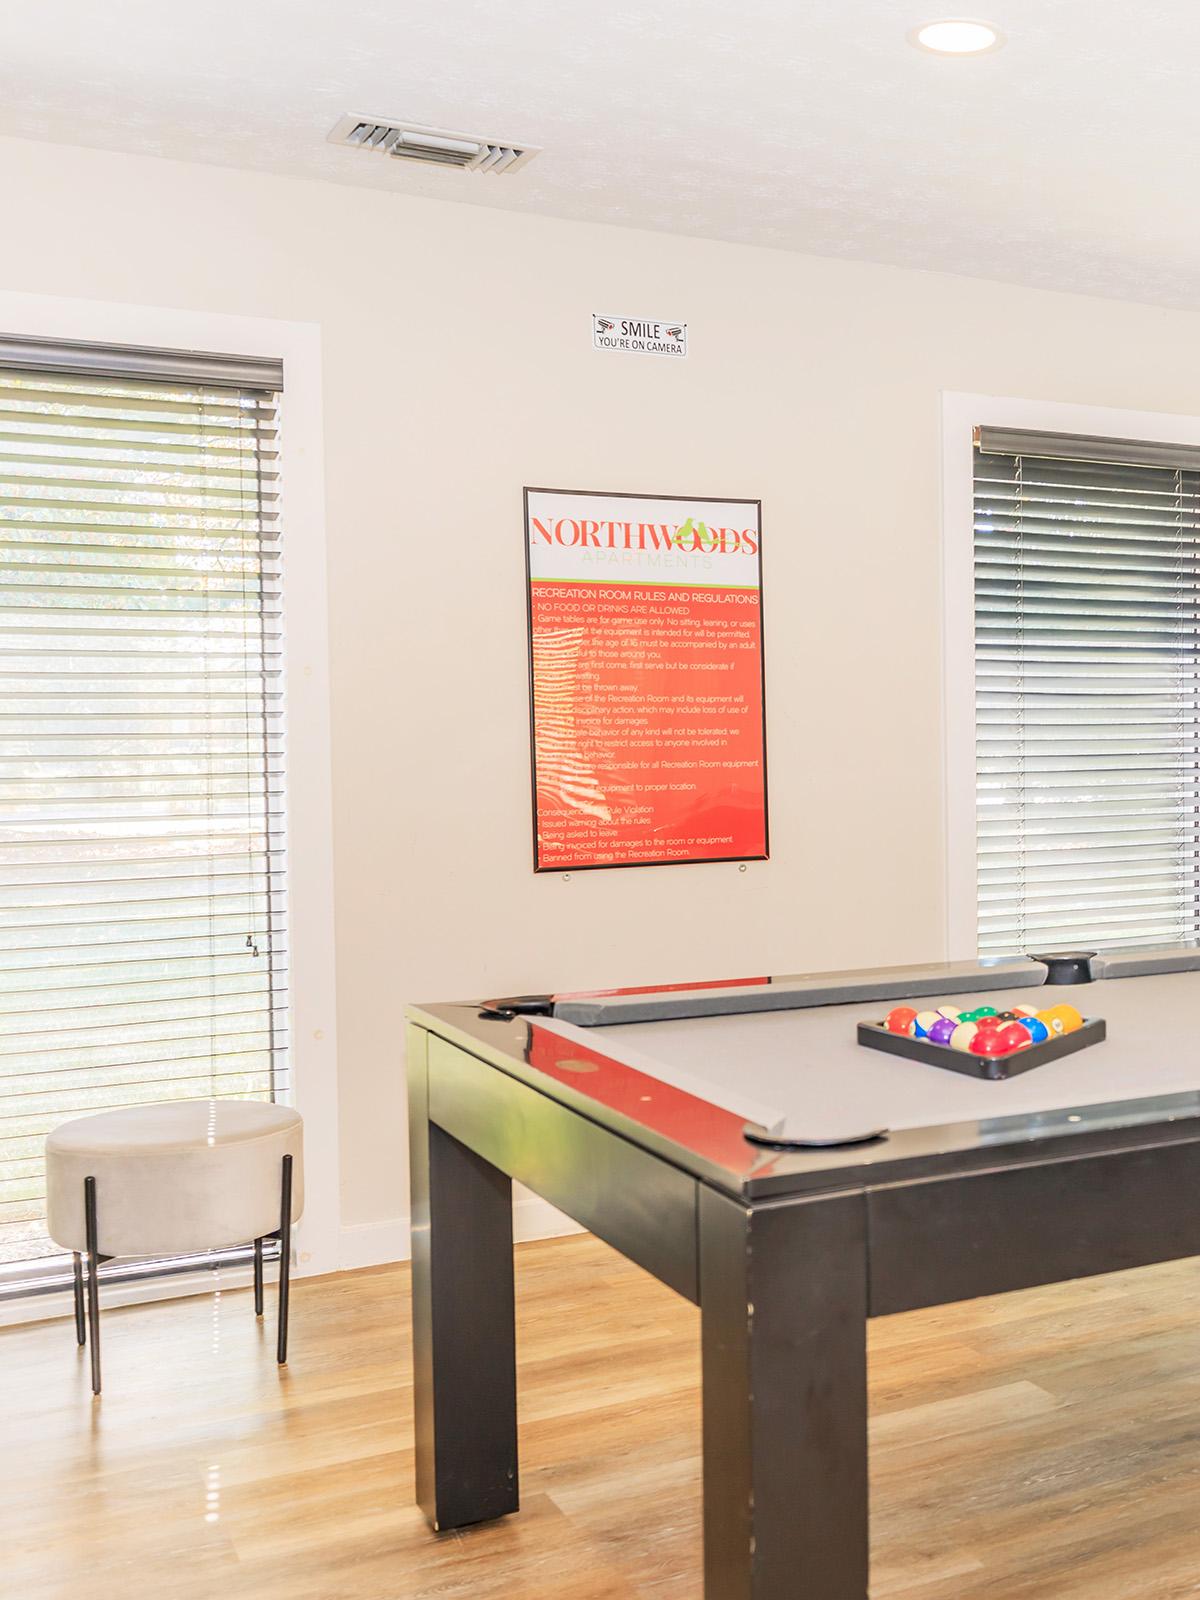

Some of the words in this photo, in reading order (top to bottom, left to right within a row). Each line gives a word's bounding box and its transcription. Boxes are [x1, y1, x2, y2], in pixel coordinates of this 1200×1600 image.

[621, 321, 660, 339] SMILE
[598, 336, 630, 349] YOU'RE
[631, 340, 645, 350] ON
[646, 341, 683, 354] CAMERA
[531, 517, 758, 556] NORTHWOODS
[581, 550, 713, 570] APARTMENTS
[531, 587, 597, 599] RECREATION
[599, 589, 632, 600] ROOM
[634, 591, 666, 602] RULES
[668, 592, 690, 602] AND
[692, 593, 759, 605] REGULATIONS
[537, 603, 553, 612] NO
[554, 603, 581, 612] FOOD
[582, 604, 596, 613] OR
[597, 604, 629, 614] DRINKS
[630, 605, 648, 615] ARE
[649, 606, 690, 615] ALLOWED
[537, 614, 561, 623] Game
[562, 615, 585, 624] tables
[586, 616, 599, 624] are
[599, 615, 609, 624] for
[610, 617, 632, 626] game
[634, 617, 648, 625] use
[667, 618, 679, 626] No
[740, 620, 756, 629] uses
[603, 628, 642, 637] equipment
[651, 629, 682, 637] intended
[682, 629, 693, 637] for
[695, 629, 705, 637] will
[706, 630, 716, 638] be
[605, 640, 619, 648] age
[620, 639, 630, 647] of
[641, 640, 658, 648] must
[659, 640, 669, 648] be
[670, 640, 718, 649] accompanied
[718, 641, 729, 650] by
[597, 649, 619, 658] those
[620, 649, 646, 658] around
[590, 661, 604, 669] first
[629, 661, 644, 670] first
[666, 662, 678, 670] but
[679, 662, 689, 670] be
[690, 662, 729, 671] considerate
[582, 684, 593, 692] be
[594, 684, 618, 692] thrown
[594, 694, 607, 702] the
[608, 694, 645, 703] Recreation
[647, 694, 670, 703] Room
[671, 695, 685, 703] and
[686, 695, 695, 703] its
[695, 695, 733, 704] equipment
[734, 695, 744, 703] will
[637, 705, 657, 714] which
[658, 707, 675, 715] may
[676, 706, 701, 714] include
[702, 706, 717, 714] loss
[718, 706, 726, 714] of
[727, 706, 740, 714] use
[741, 706, 749, 714] of
[576, 717, 601, 726] invoice
[602, 716, 613, 725] for
[588, 728, 620, 736] behavior
[621, 728, 630, 736] of
[630, 729, 644, 737] any
[645, 728, 661, 736] kind
[661, 727, 673, 735] will
[686, 728, 697, 736] be
[604, 739, 628, 748] restrict
[628, 739, 654, 747] access
[654, 738, 664, 747] to
[664, 739, 690, 748] anyone
[691, 738, 720, 747] involved
[721, 738, 728, 746] in
[597, 761, 639, 770] responsible
[640, 760, 650, 769] for
[661, 760, 697, 769] Recreation
[699, 760, 721, 769] Room
[722, 760, 760, 769] equipment
[635, 783, 644, 791] to
[644, 784, 668, 792] proper
[623, 805, 655, 814] Violation
[542, 820, 567, 828] Issued
[567, 819, 597, 829] warning
[598, 818, 620, 827] about
[620, 817, 632, 825] the
[542, 831, 565, 840] Being
[566, 830, 588, 839] asked
[589, 830, 598, 838] to
[599, 829, 618, 837] leave
[542, 842, 565, 851] Being
[566, 840, 597, 850] invoiced
[598, 839, 609, 849] for
[609, 839, 644, 848] damages
[645, 838, 653, 846] to
[653, 838, 666, 846] the
[666, 838, 686, 846] room
[542, 853, 573, 863] Banned
[574, 853, 592, 861] from
[593, 852, 614, 861] using
[614, 851, 627, 859] the
[627, 849, 665, 859] Recreation
